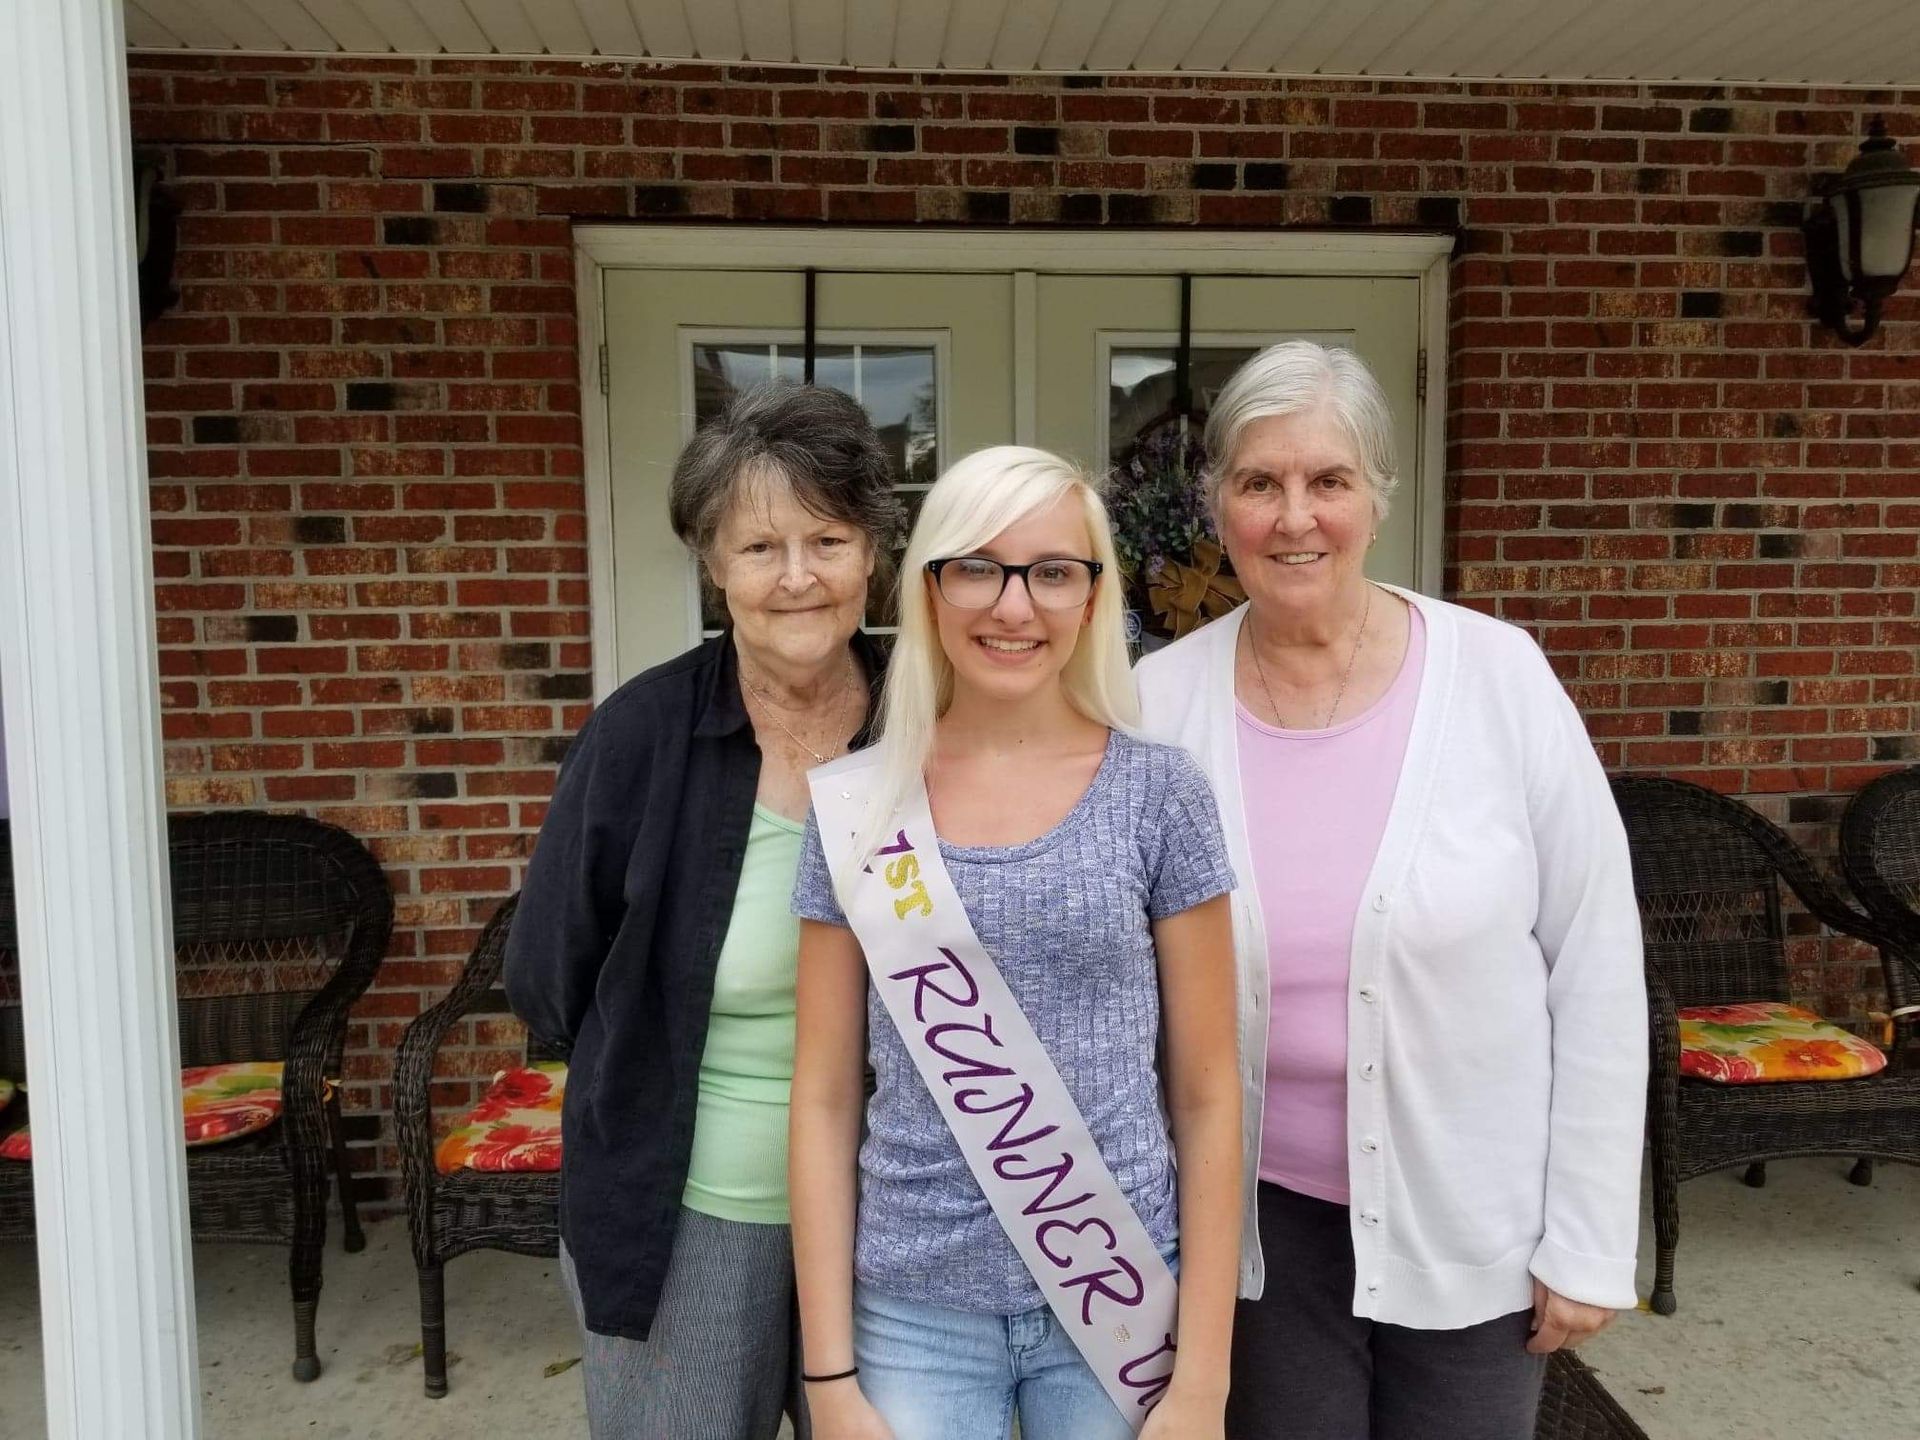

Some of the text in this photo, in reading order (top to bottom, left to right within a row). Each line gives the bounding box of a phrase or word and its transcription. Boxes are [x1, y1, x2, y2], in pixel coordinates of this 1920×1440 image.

[852, 829, 1178, 1420] 1ST RUNNER U
